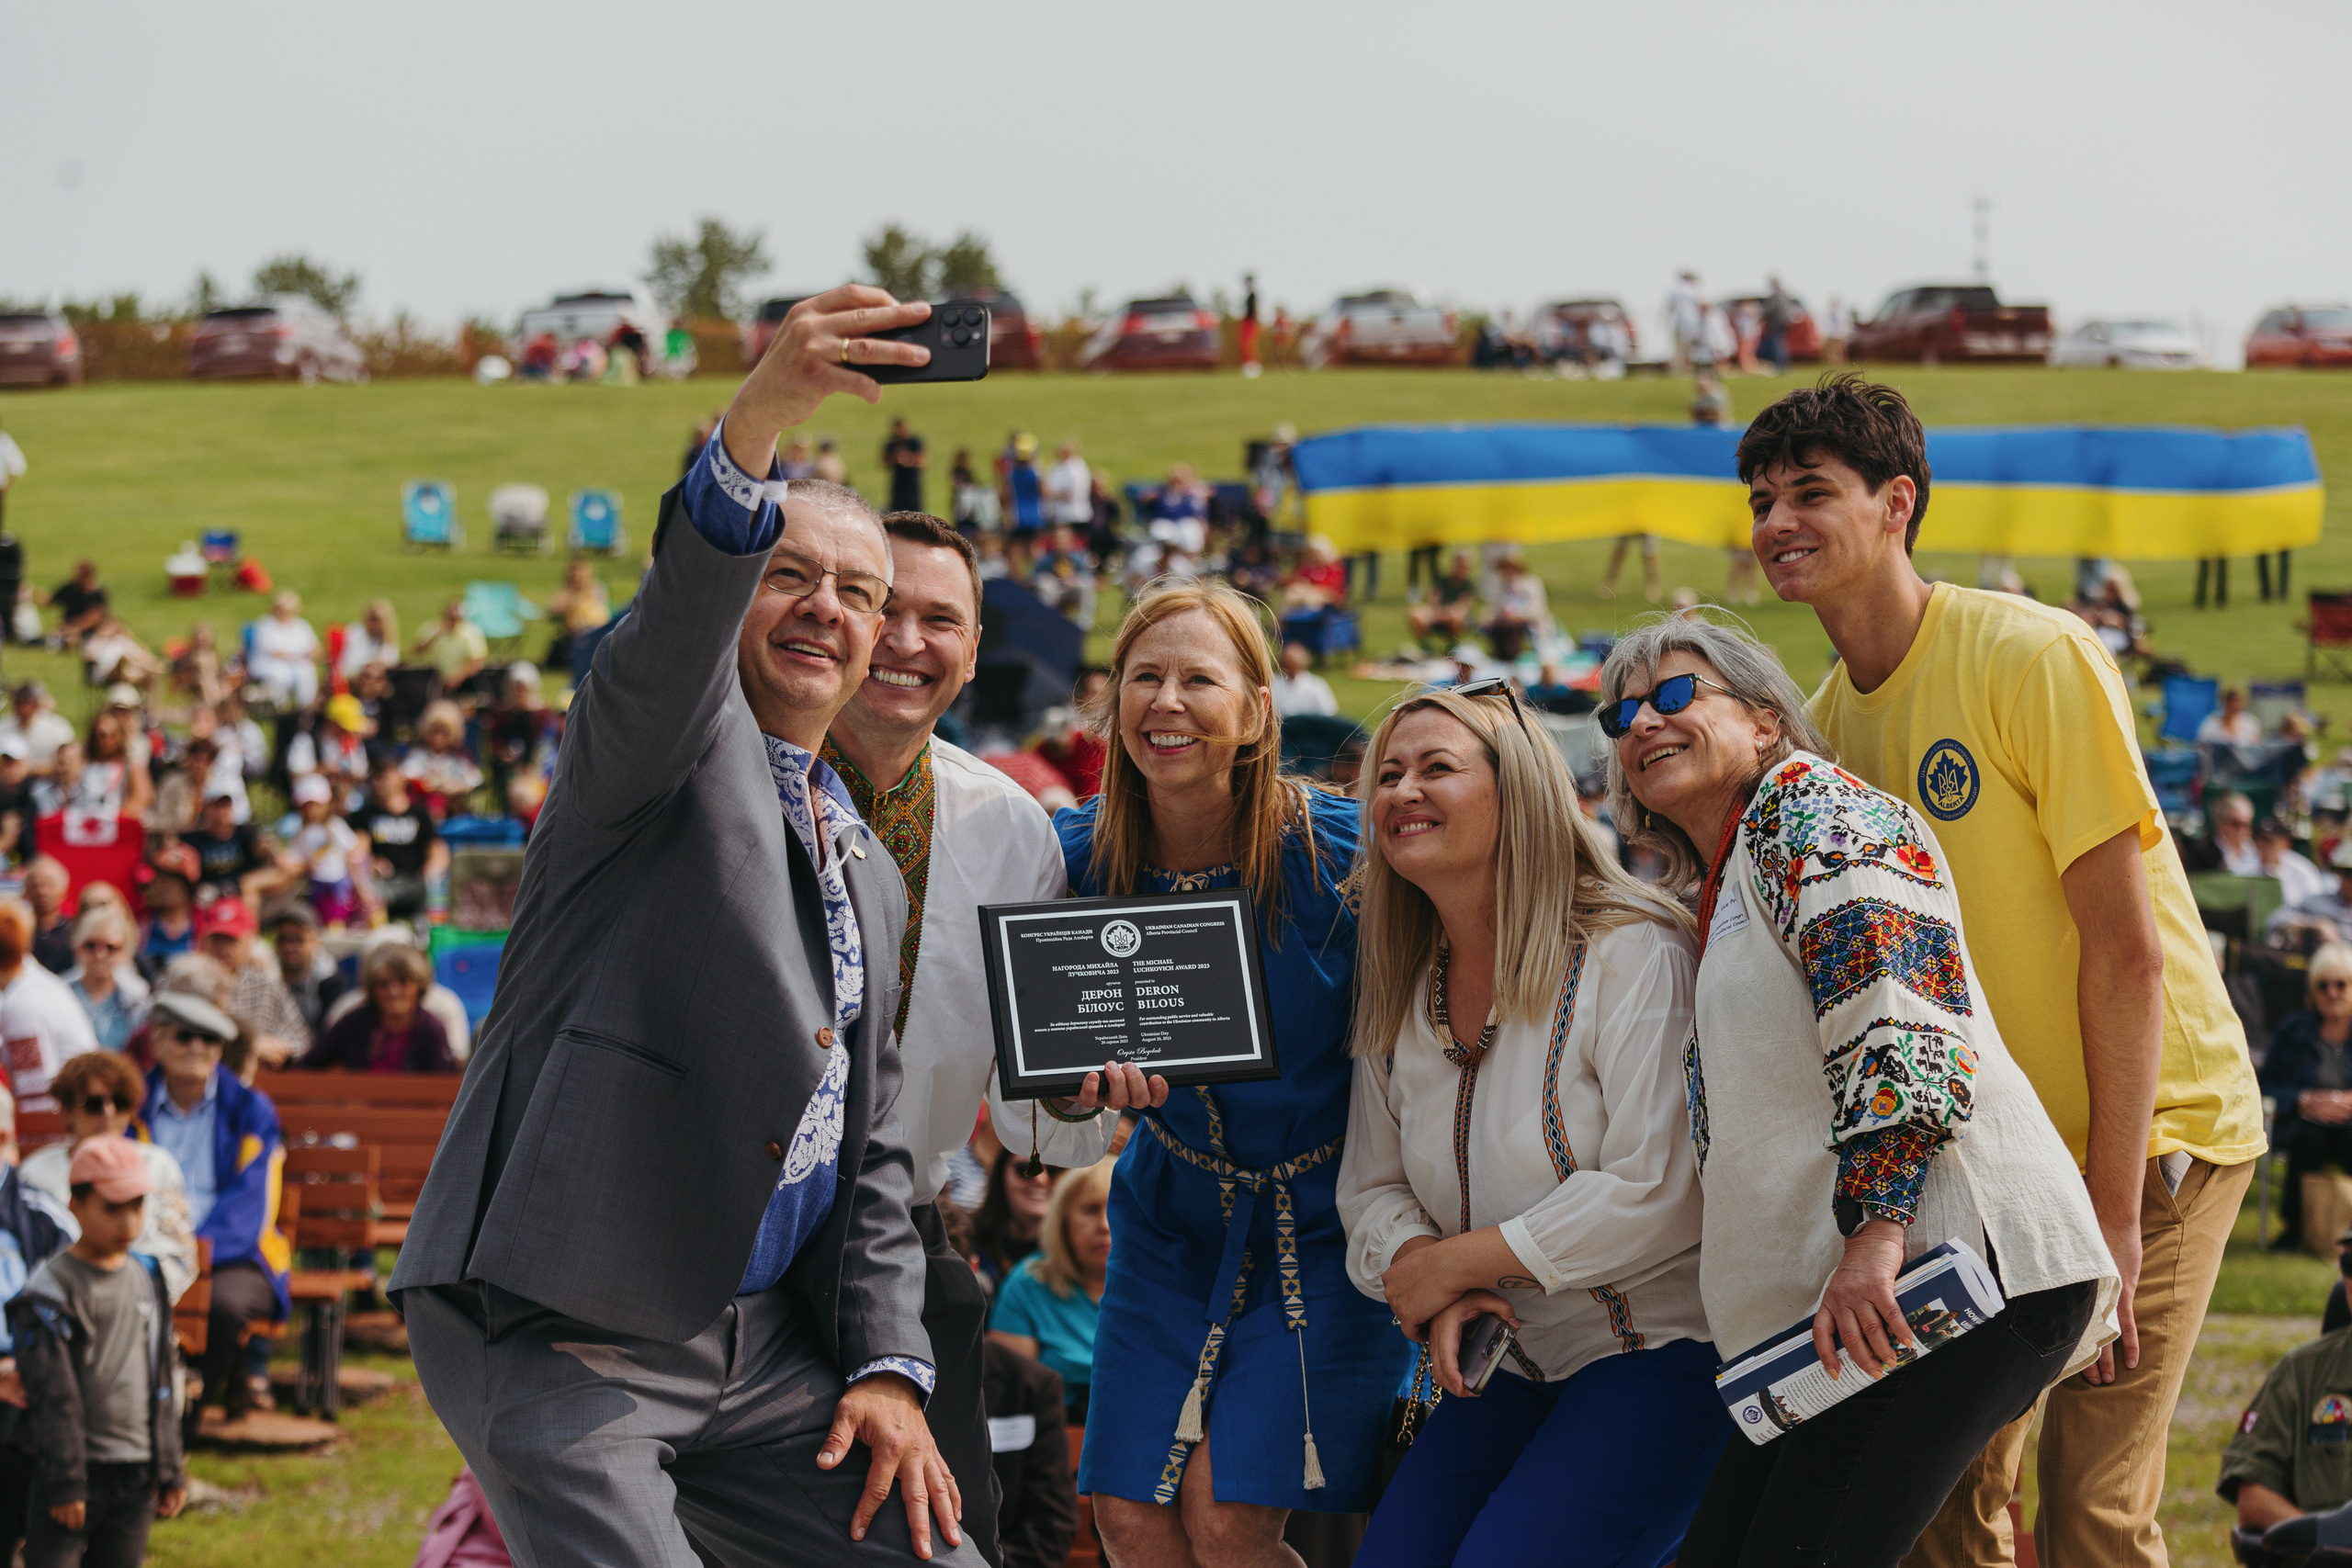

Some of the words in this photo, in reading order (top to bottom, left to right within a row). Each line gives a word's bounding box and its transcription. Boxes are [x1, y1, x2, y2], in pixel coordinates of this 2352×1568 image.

[1920, 750, 1934, 778] Ukrainian
[1934, 742, 1954, 751] Canadian
[1954, 743, 1973, 766] Congress
[1938, 796, 1965, 809] ALBERTA
[1052, 964, 1086, 972] НАГОРОДА
[1133, 965, 1174, 974] LUCHKOVICH
[1081, 988, 1123, 1002] ДЕРОН
[1136, 985, 1180, 997] DERON
[1077, 1001, 1125, 1014] БІЛОУС
[1136, 997, 1185, 1010] BILOUS
